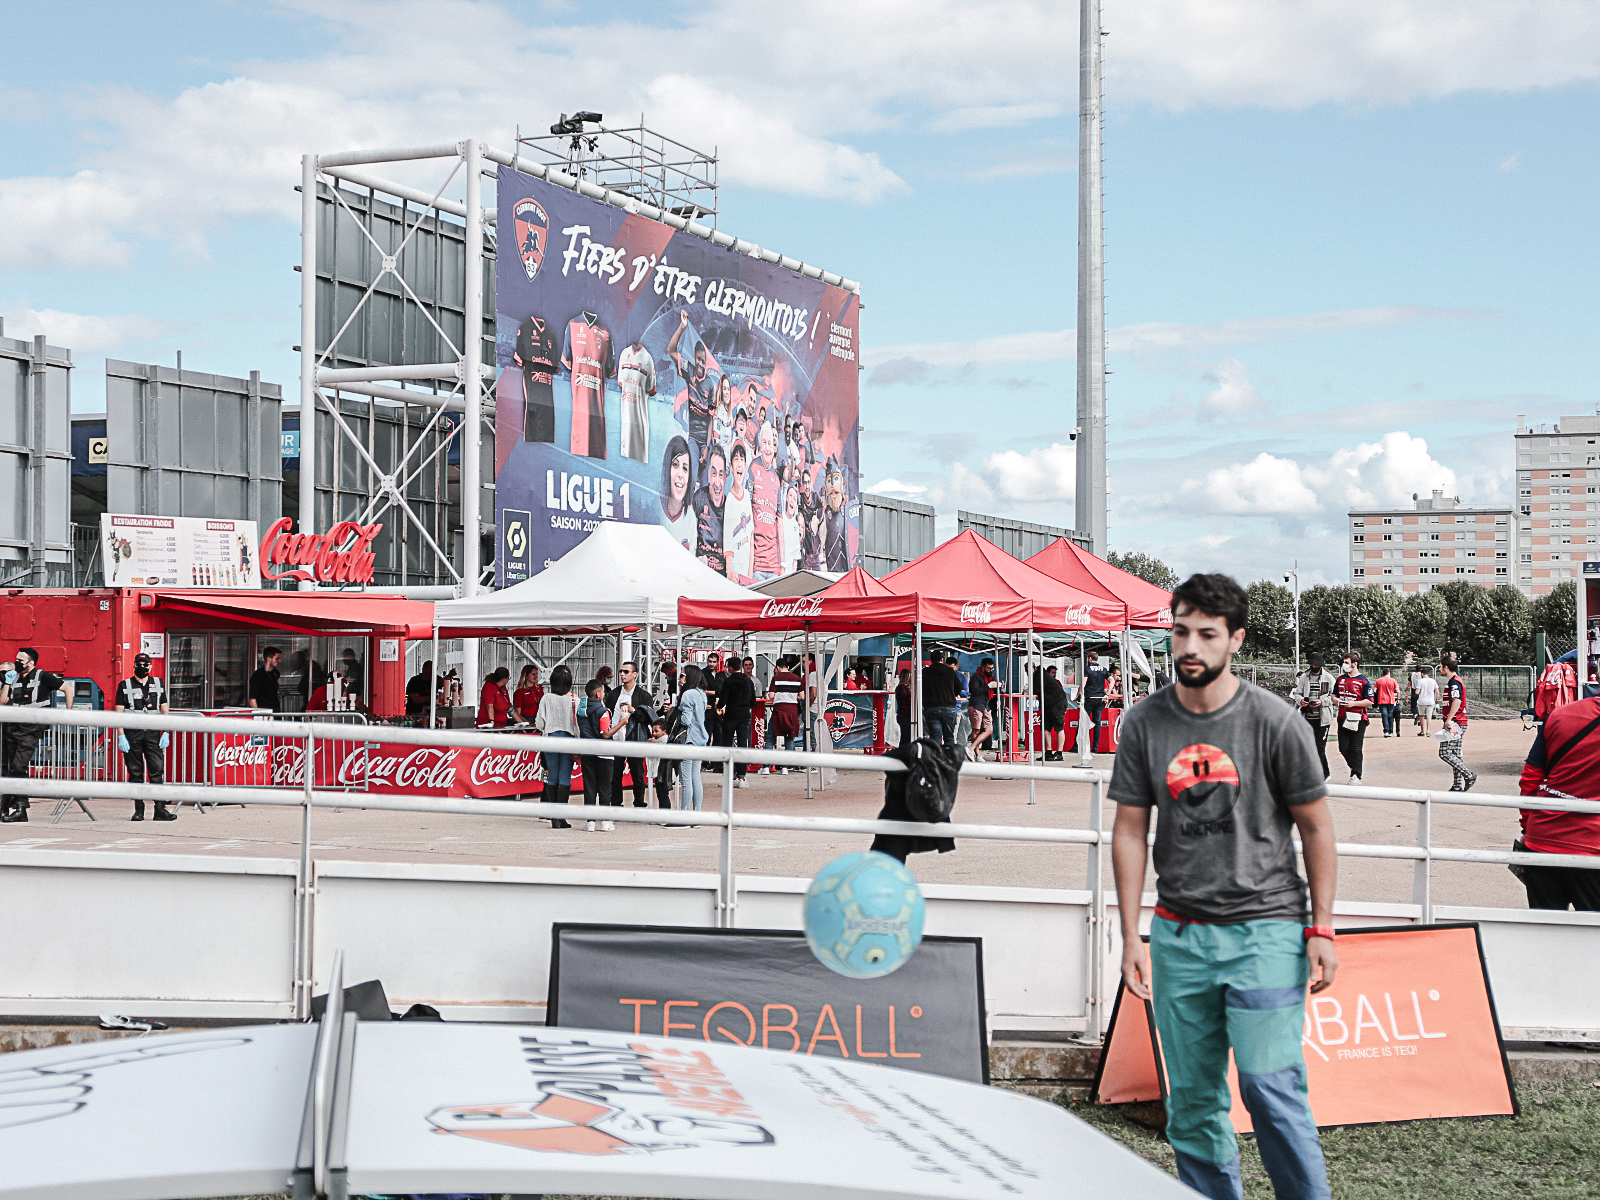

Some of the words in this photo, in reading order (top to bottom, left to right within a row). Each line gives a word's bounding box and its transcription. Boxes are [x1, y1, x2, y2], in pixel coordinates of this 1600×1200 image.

[562, 225, 627, 285] FIERS
[705, 279, 808, 341] CLERMONTOIS
[546, 469, 614, 519] LIGUE
[619, 482, 630, 519] 1
[113, 517, 152, 527] RESTAURATION
[153, 519, 172, 528] FROIDE
[207, 522, 234, 531] BOISSONS
[551, 515, 582, 530] SAISON
[507, 561, 523, 570] LIGUE
[760, 597, 824, 618] Coca-Cola
[960, 601, 994, 624] Coca-Cola
[1065, 604, 1093, 625] Coca-Cola
[214, 740, 268, 768] Coca-Cola
[338, 746, 461, 788] Coca-Cola
[1338, 1047, 1381, 1060] FRANCE
[1381, 1046, 1393, 1057] IS
[1393, 1044, 1418, 1056] TEQ!
